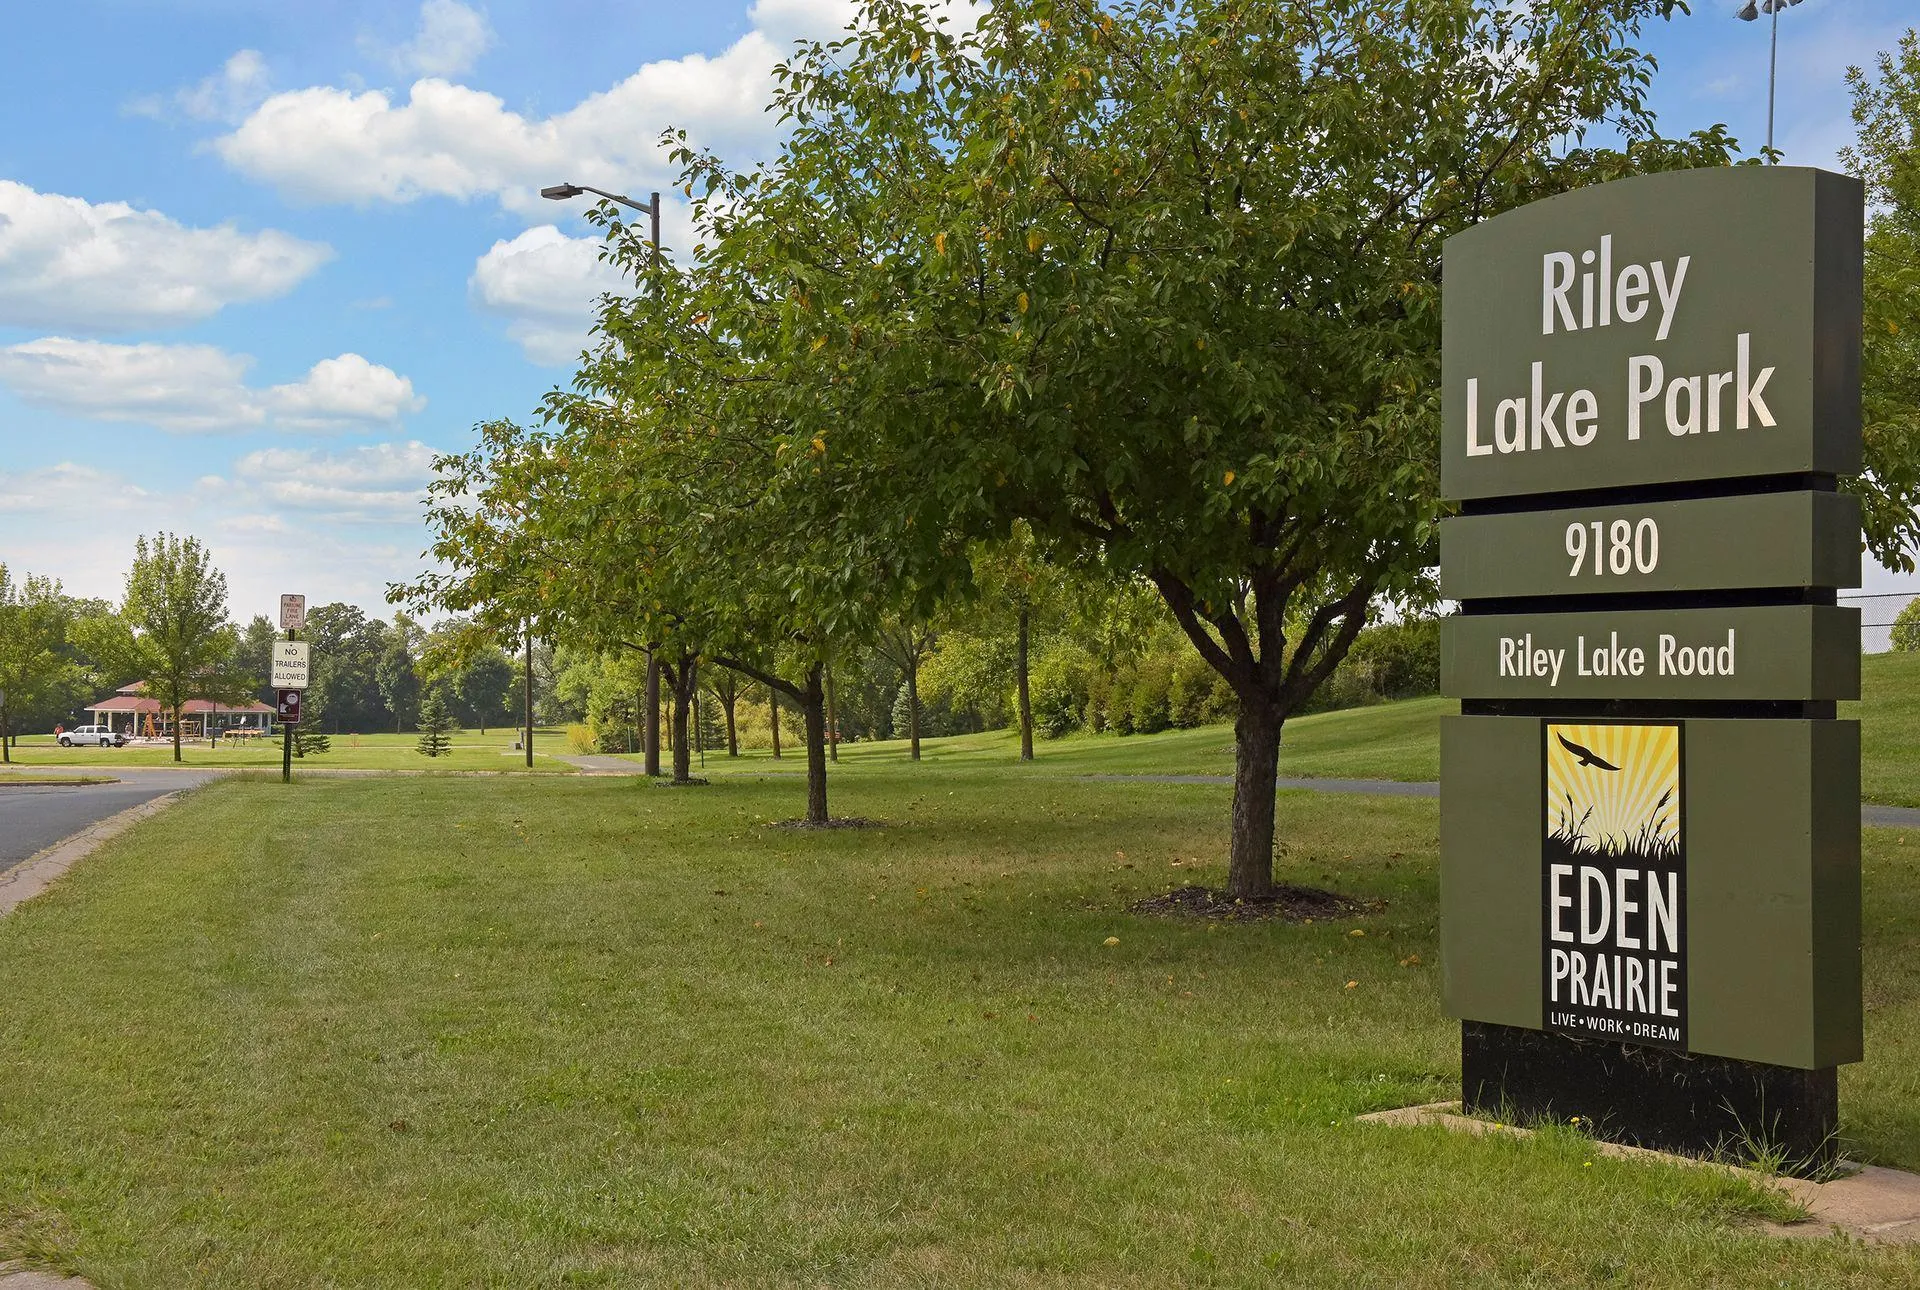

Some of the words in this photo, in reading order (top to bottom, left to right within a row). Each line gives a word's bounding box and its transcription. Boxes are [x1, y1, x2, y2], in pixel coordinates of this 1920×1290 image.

[1542, 234, 1691, 341] Riley
[1466, 361, 1598, 457] Lake
[1628, 332, 1778, 441] Park
[1565, 517, 1659, 577] 9180
[275, 660, 306, 668] TRAILERS
[1499, 633, 1565, 687] Riley
[1577, 631, 1645, 677] Lake
[1658, 628, 1736, 676] Road
[1550, 863, 1678, 953] EDEN
[1551, 948, 1679, 1018] PRAIRIE
[1551, 1011, 1577, 1027] LIVE
[1586, 1016, 1624, 1034] WORK
[1633, 1022, 1680, 1042] DREAM
